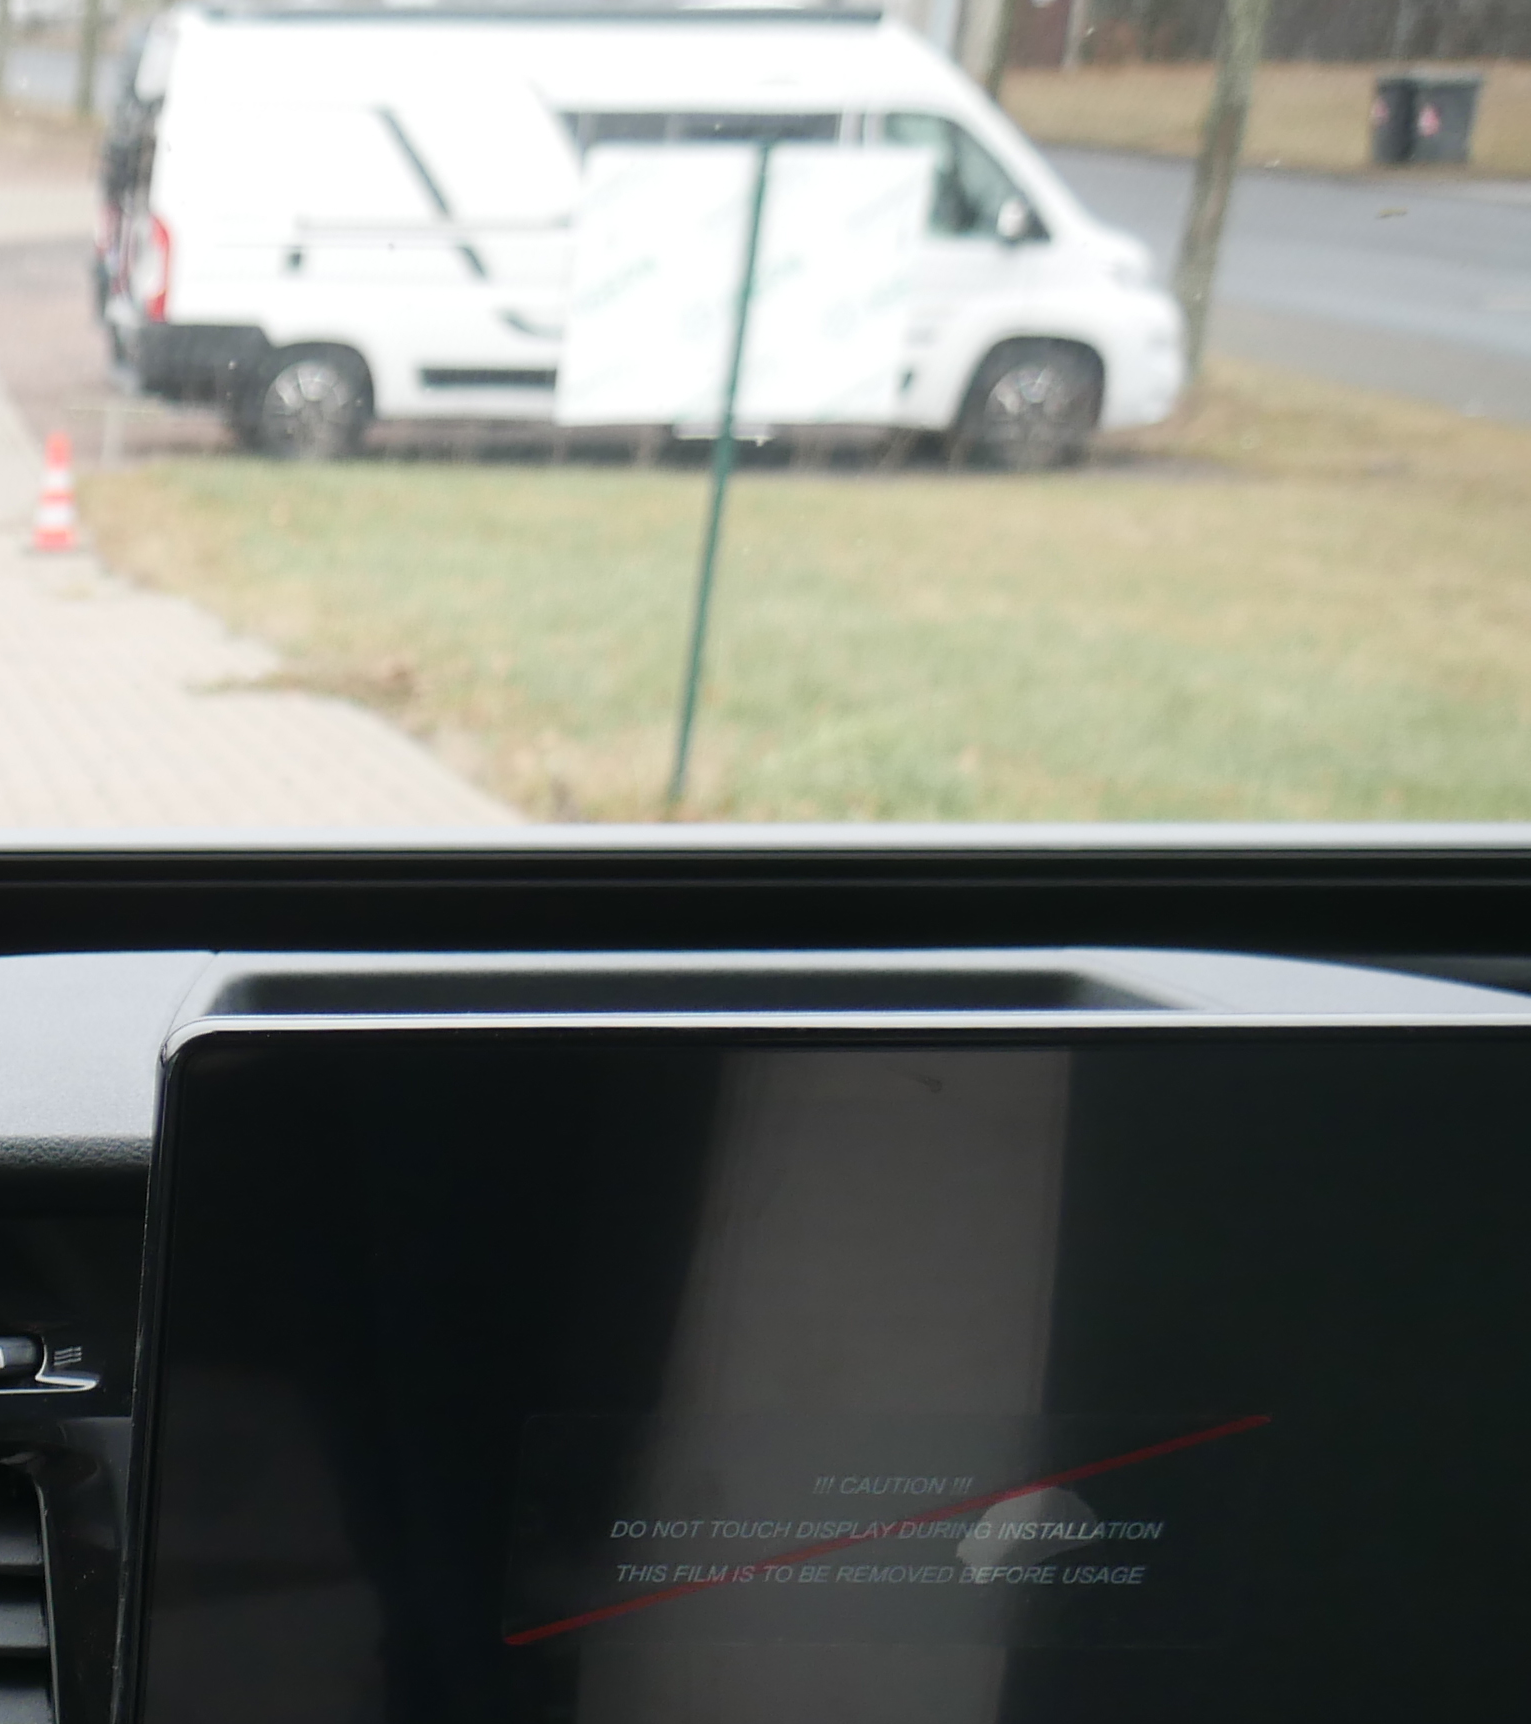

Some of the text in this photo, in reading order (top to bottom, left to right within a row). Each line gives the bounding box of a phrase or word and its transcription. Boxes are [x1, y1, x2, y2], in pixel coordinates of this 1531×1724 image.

[839, 1475, 944, 1495] CAUTION
[610, 1520, 1164, 1541] DO NOT TOUCH DISPLAY DURING INSTALLATION
[616, 1564, 1146, 1585] THIS FILM IS TO BE REMOVED BEFORE USAGE
